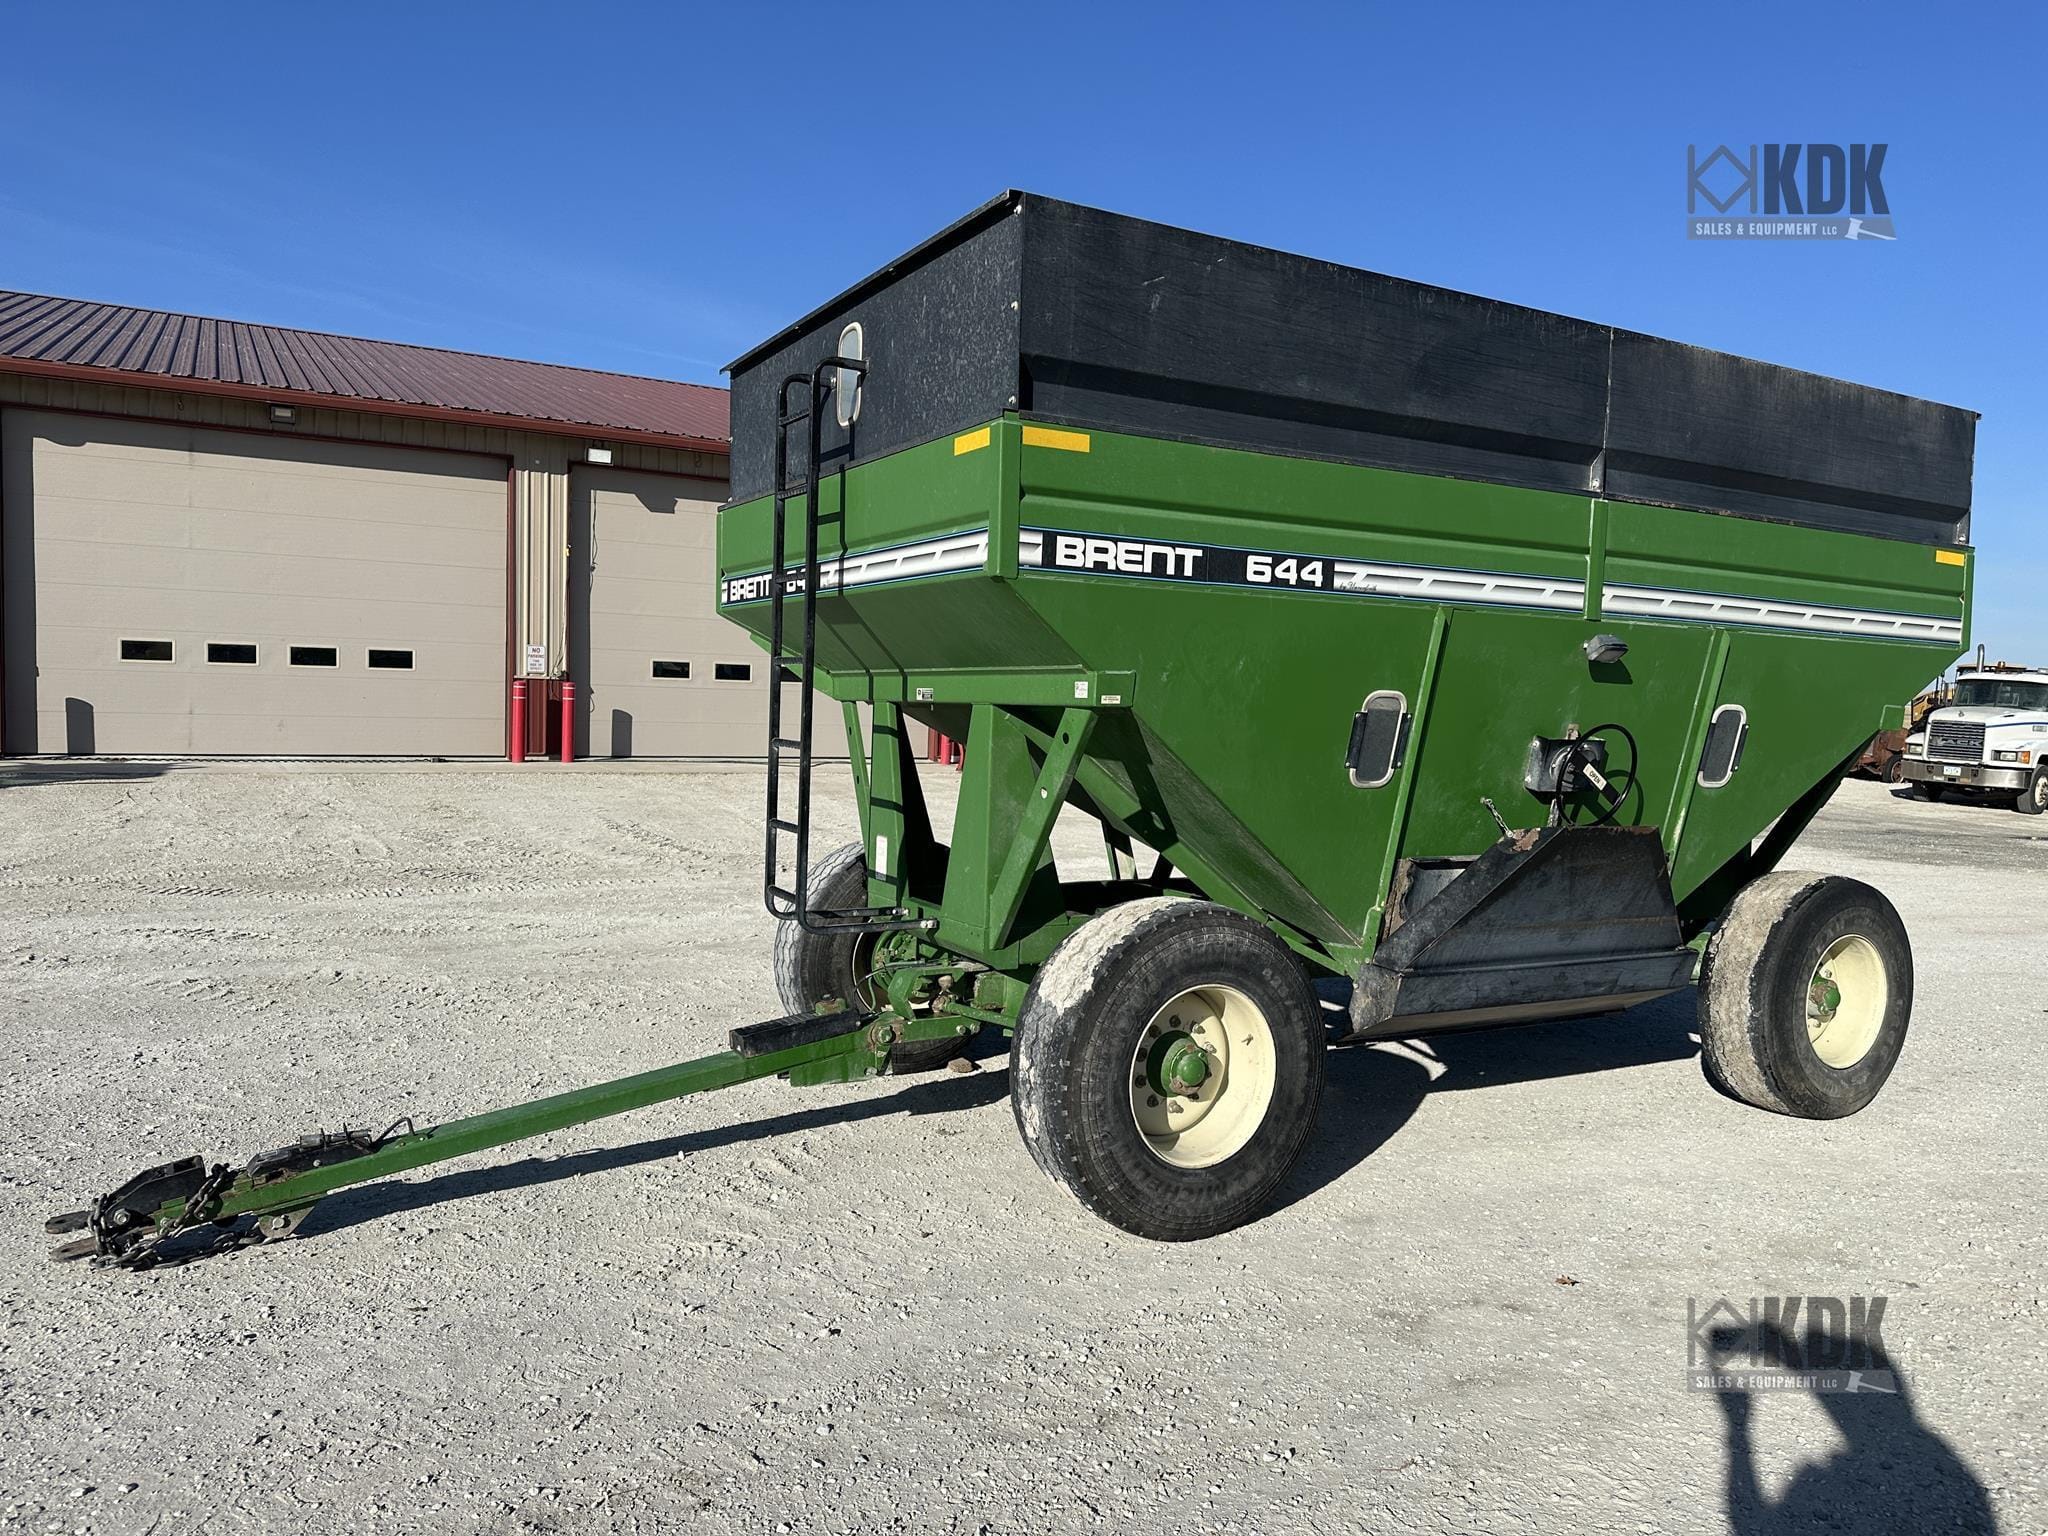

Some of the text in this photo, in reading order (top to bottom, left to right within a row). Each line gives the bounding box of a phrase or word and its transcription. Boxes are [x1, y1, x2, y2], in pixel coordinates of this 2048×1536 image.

[1055, 535, 1323, 588] BRENT 644
[729, 573, 773, 602] BRENT
